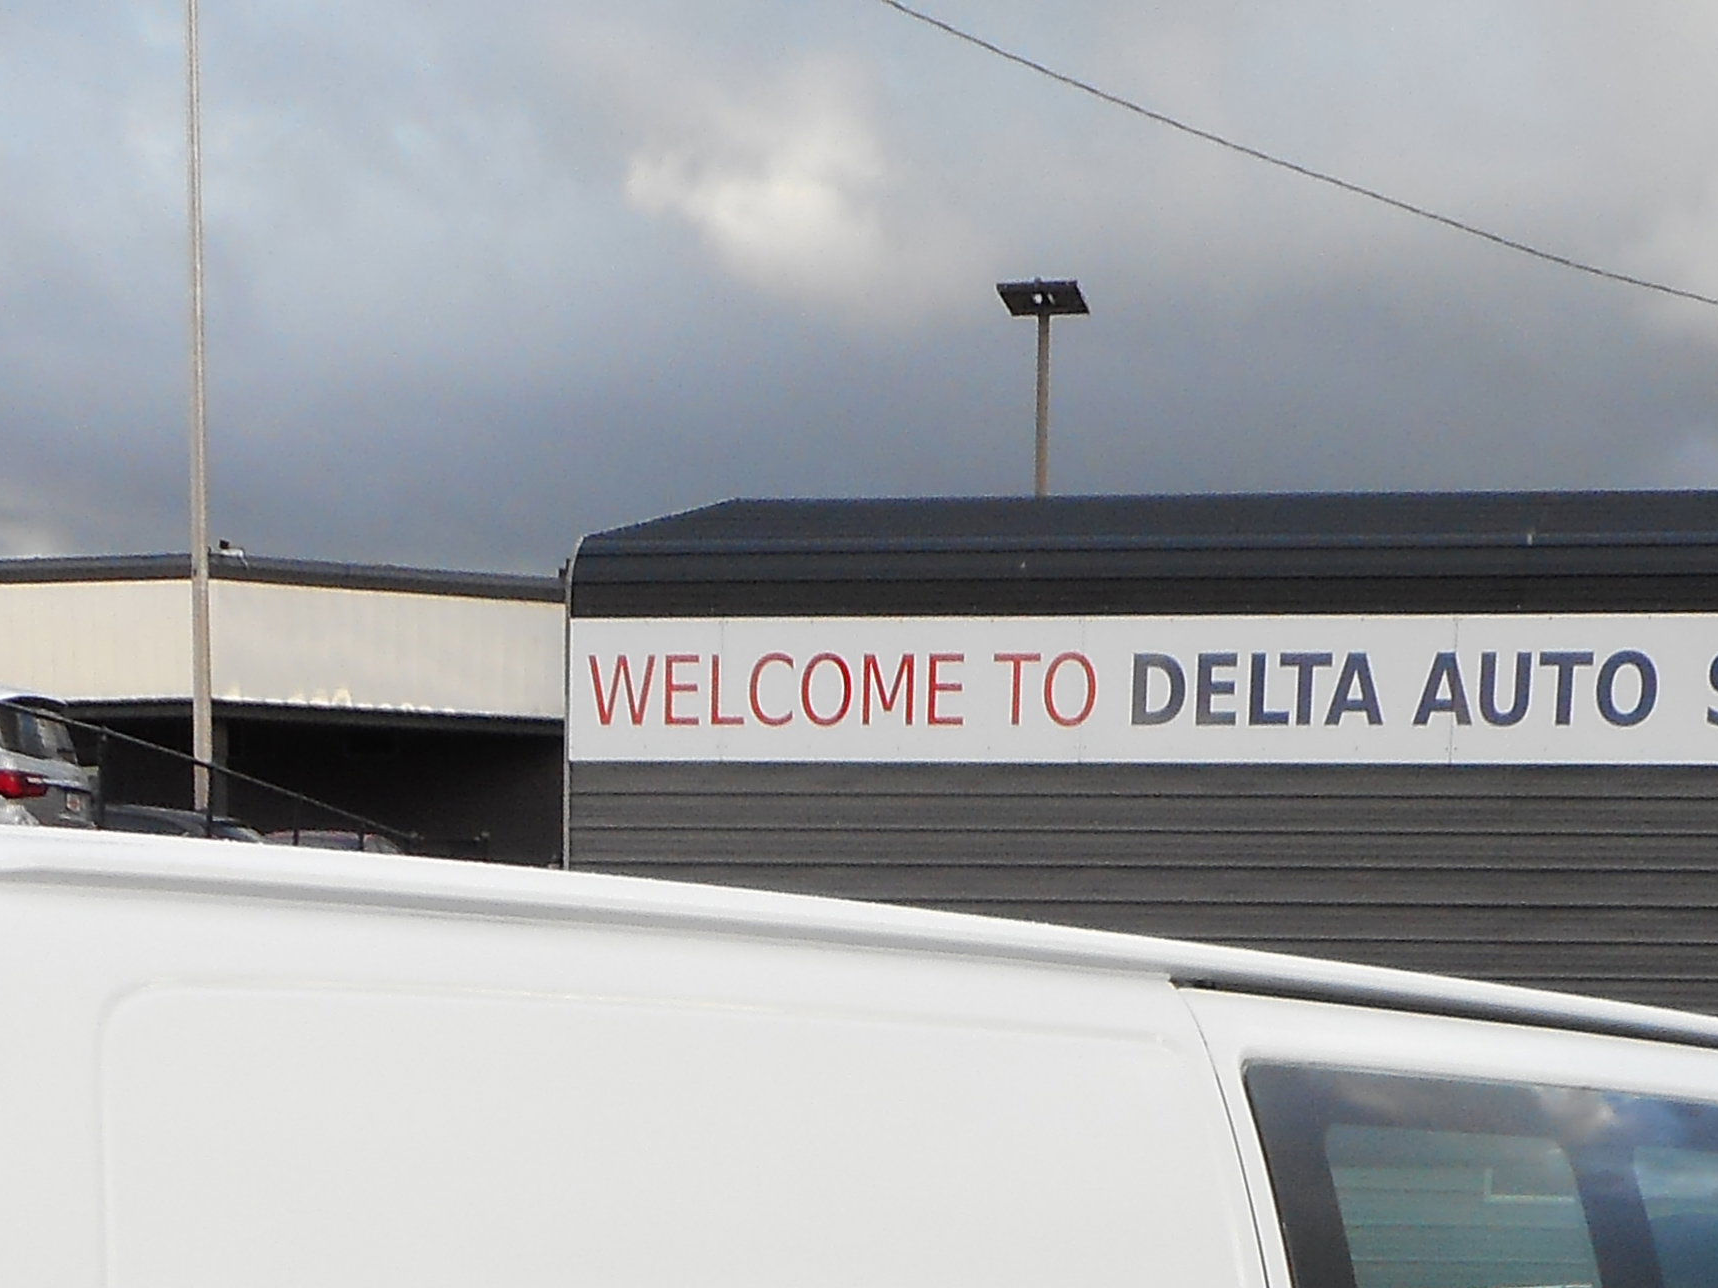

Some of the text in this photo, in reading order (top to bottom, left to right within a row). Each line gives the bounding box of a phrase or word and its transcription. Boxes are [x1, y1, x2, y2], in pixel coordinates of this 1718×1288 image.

[587, 651, 965, 727] WELCOME
[993, 651, 1099, 727] TO
[1129, 650, 1384, 727] DELTA
[1411, 648, 1659, 728] AUTO
